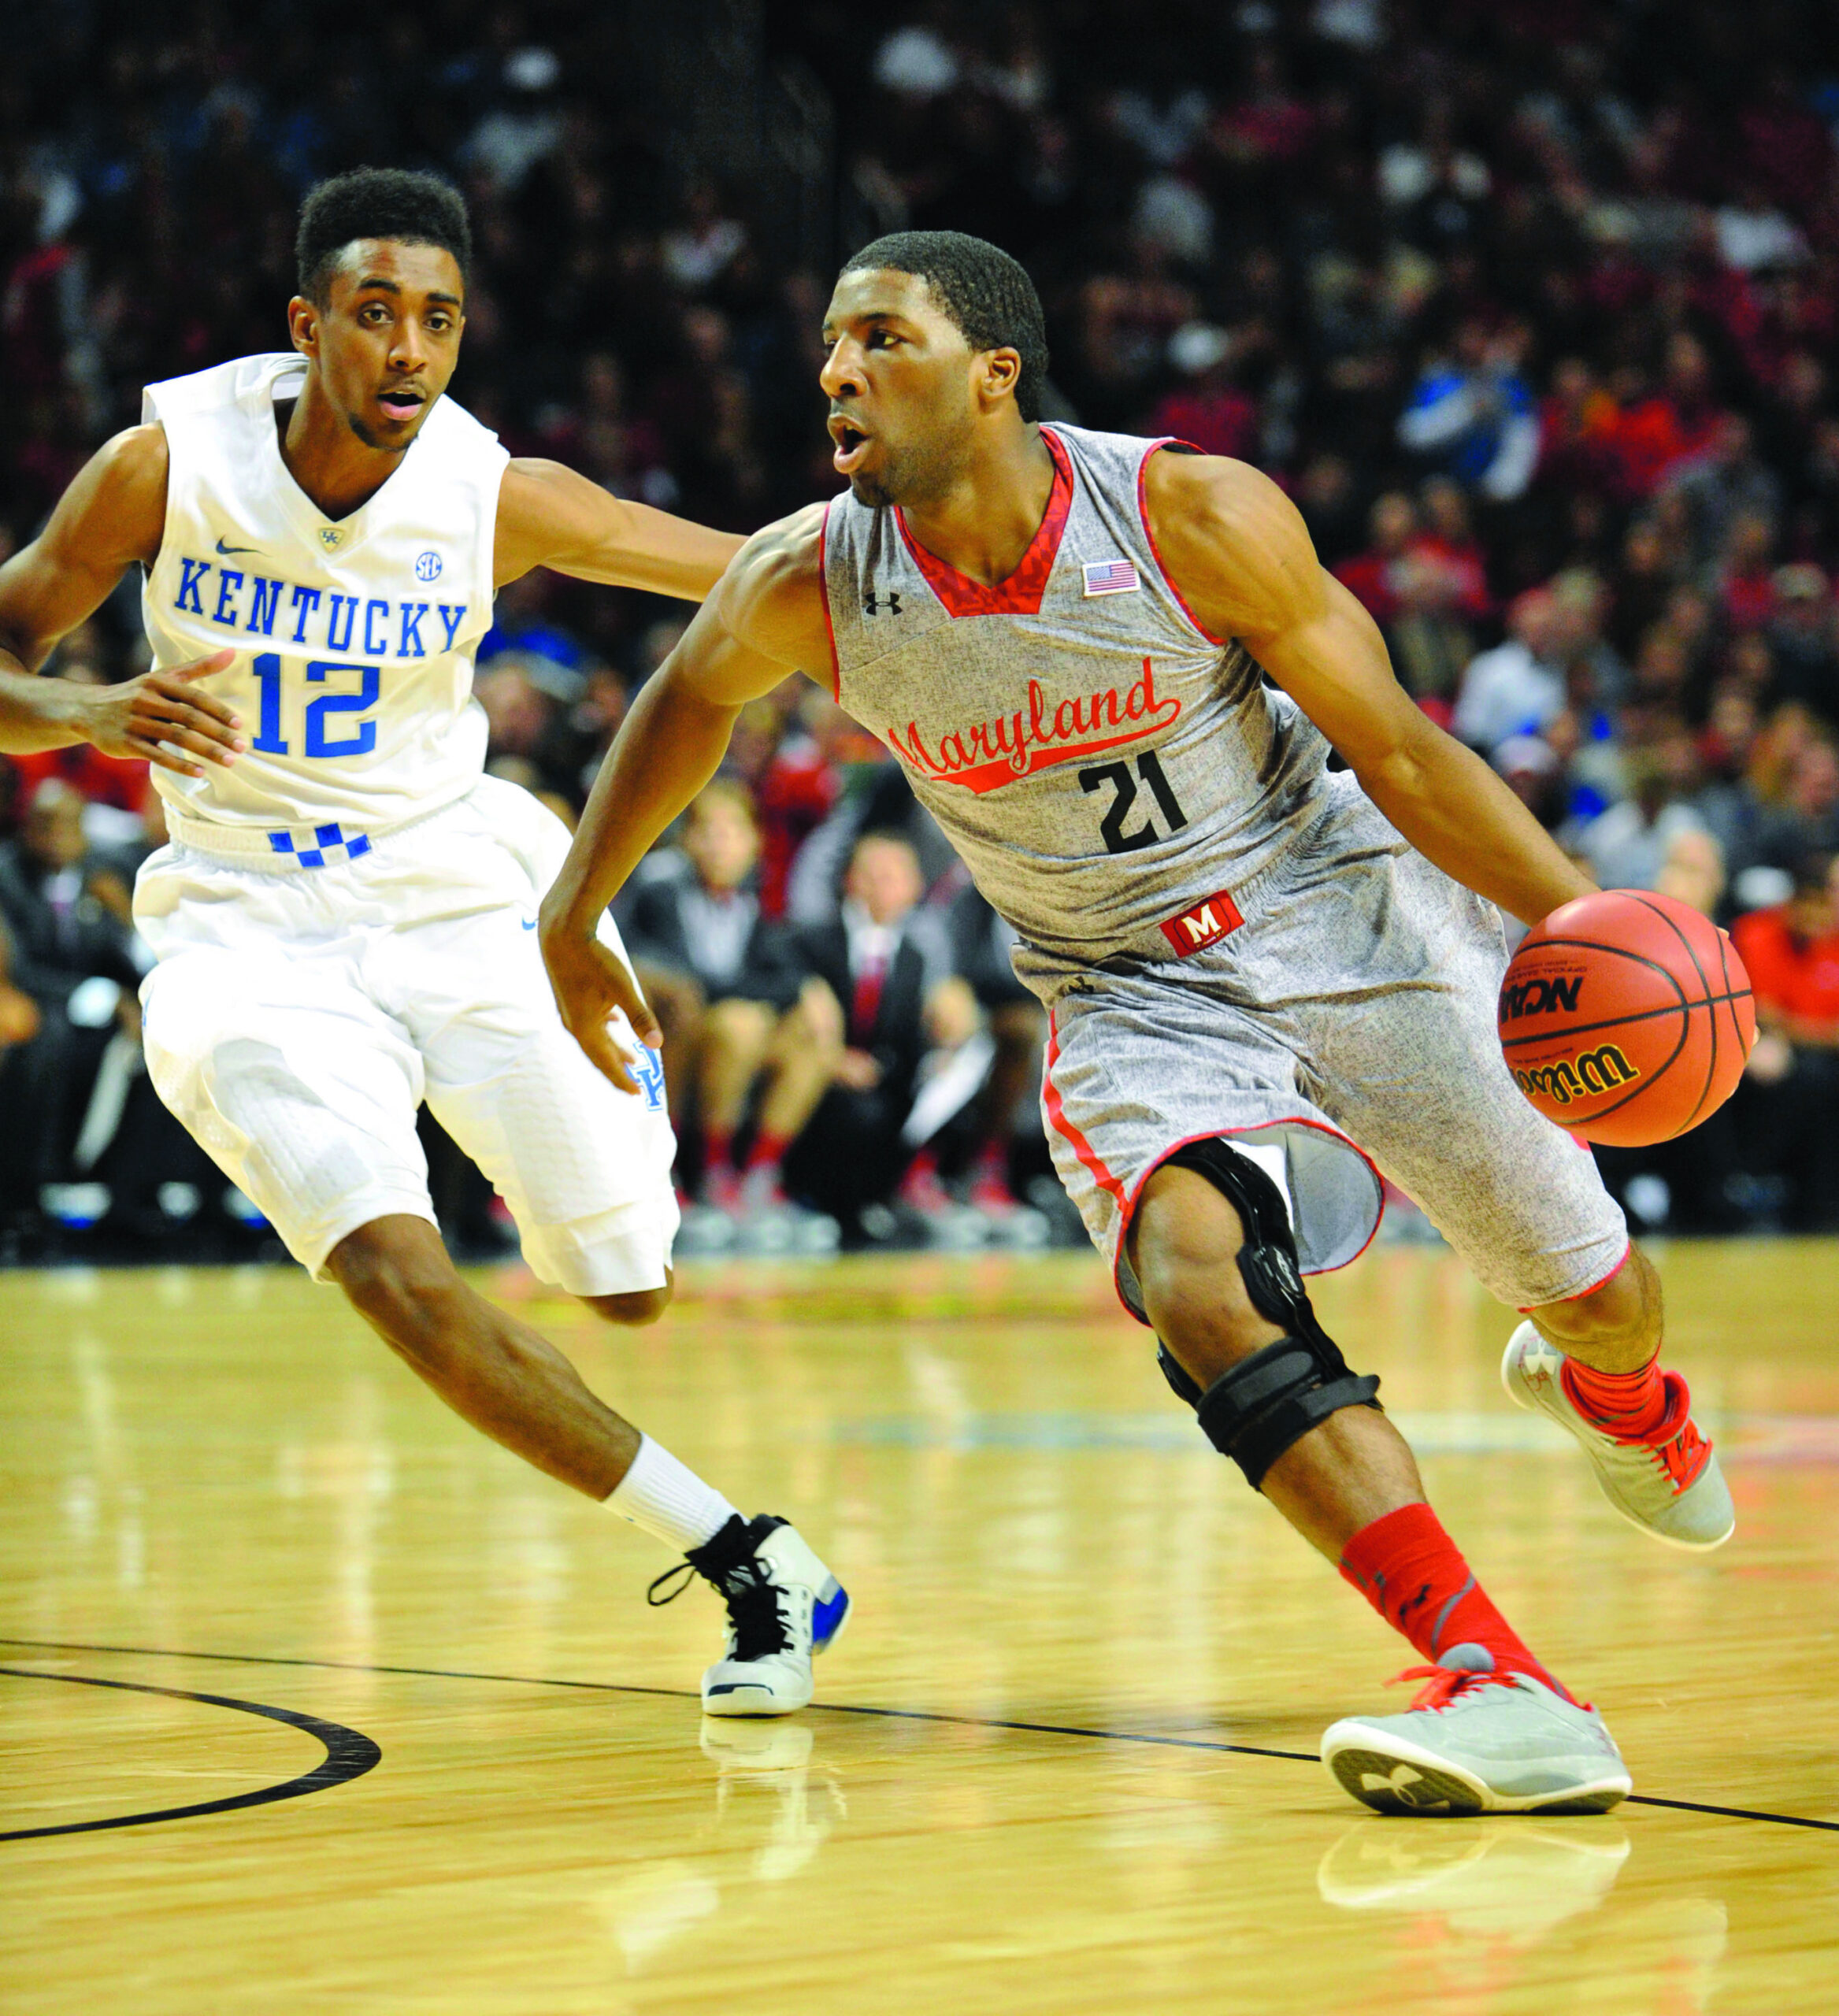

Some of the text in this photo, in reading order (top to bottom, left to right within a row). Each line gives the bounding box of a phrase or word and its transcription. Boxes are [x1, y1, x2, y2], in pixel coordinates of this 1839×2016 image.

[174, 557, 467, 658] KENTUCKY
[417, 553, 442, 580] SEC
[252, 652, 380, 758] 12
[888, 655, 1181, 776] Maryland
[1077, 749, 1188, 854] 21
[1181, 903, 1222, 944] M
[1510, 1043, 1641, 1104] Wilso
